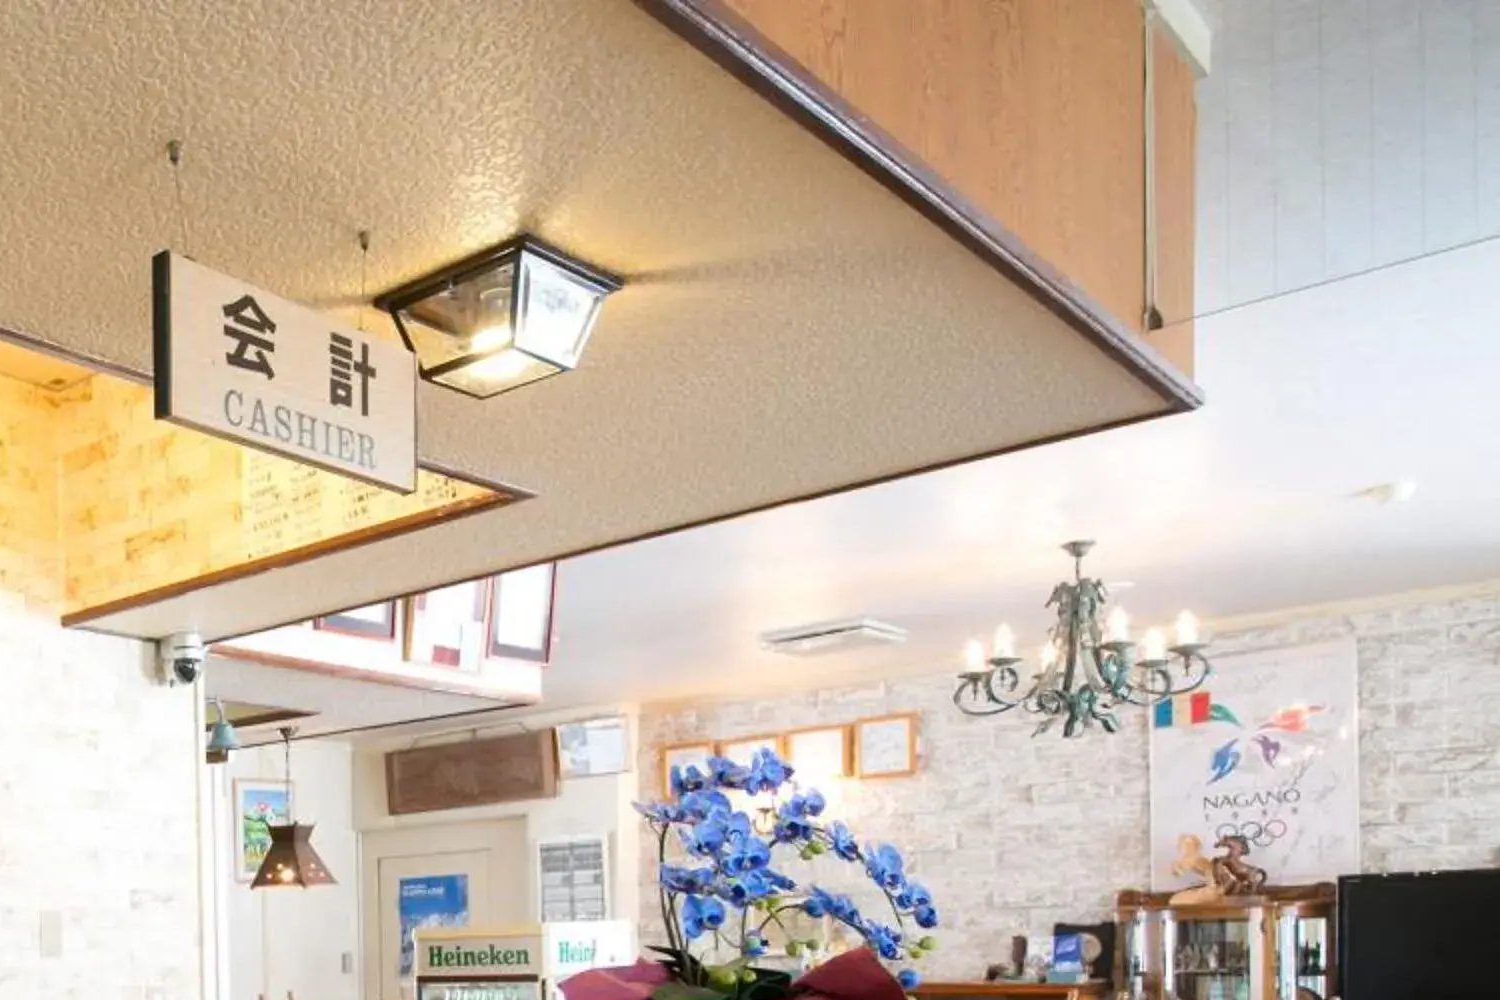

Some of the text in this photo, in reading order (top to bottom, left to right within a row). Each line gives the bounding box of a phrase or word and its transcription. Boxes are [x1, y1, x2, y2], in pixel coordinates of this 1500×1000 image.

[222, 294, 377, 417] 会計
[224, 389, 377, 470] CASHIER
[1203, 788, 1301, 809] NAGANO
[428, 944, 529, 967] Heineken
